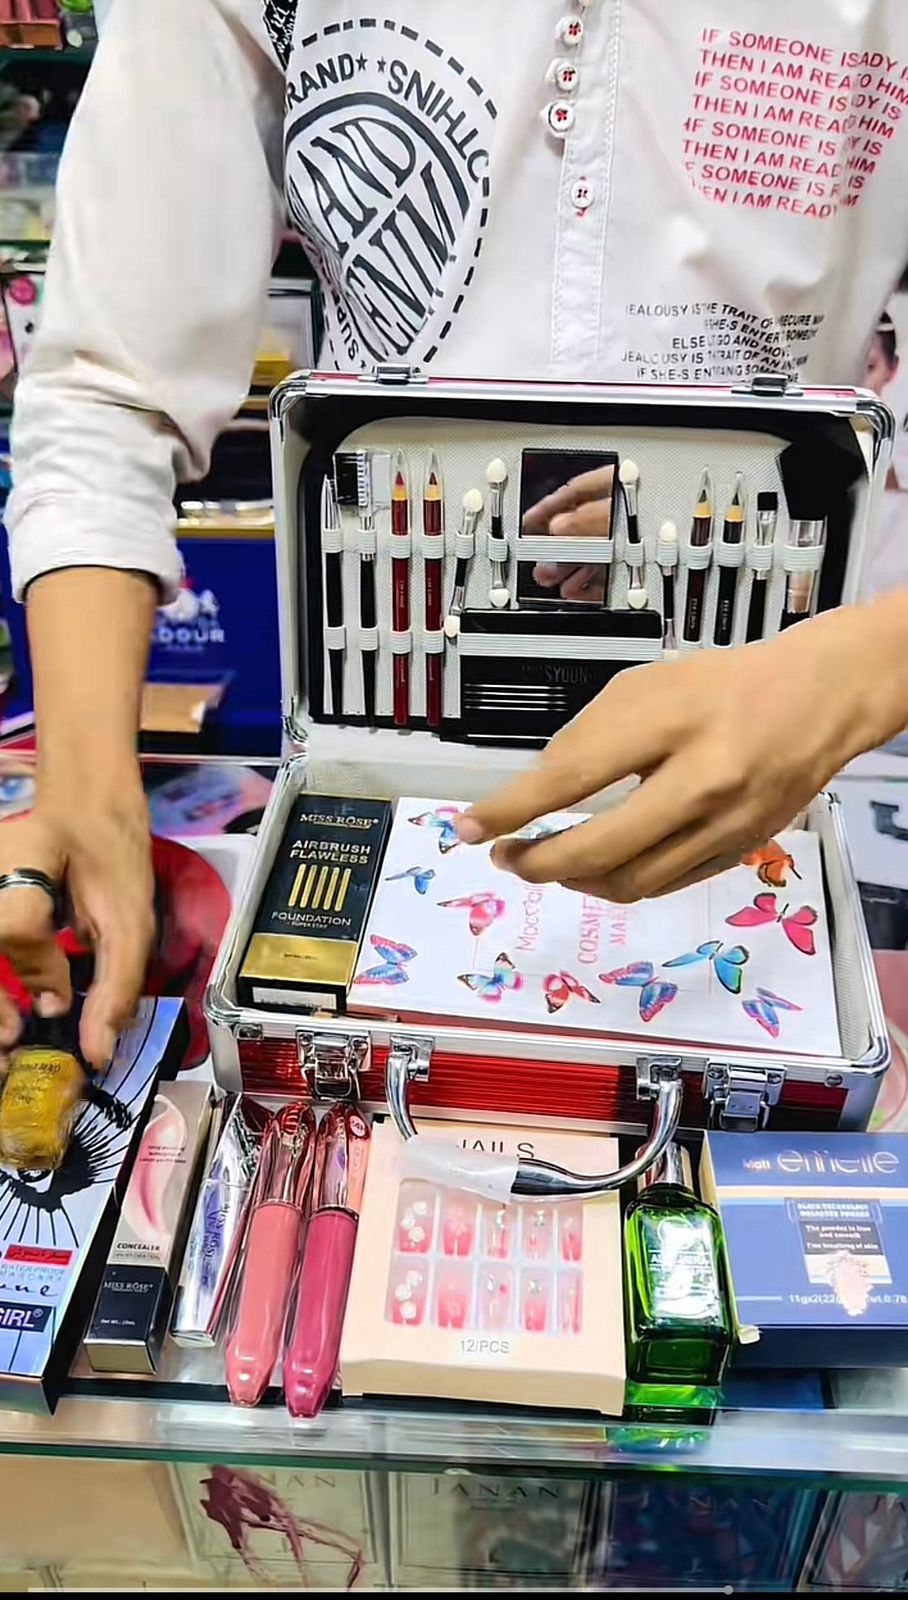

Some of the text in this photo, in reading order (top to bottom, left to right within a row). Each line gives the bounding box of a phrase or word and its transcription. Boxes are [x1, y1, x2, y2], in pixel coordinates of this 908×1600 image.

[702, 28, 722, 43] IF
[729, 31, 834, 64] SOMEONE
[699, 49, 754, 73] THEN
[761, 58, 766, 74] I
[771, 61, 803, 79] AM
[694, 71, 714, 88] IF
[721, 75, 824, 105] SOMEONE
[829, 95, 847, 111] IS
[881, 101, 901, 120] IS
[693, 93, 747, 116] THEN
[753, 103, 758, 118] I
[763, 105, 794, 123] AM
[858, 115, 894, 138] HIM
[684, 117, 705, 132] IF
[712, 121, 811, 150] SOMEONE
[818, 140, 836, 156] IS
[863, 139, 883, 155] IS
[683, 139, 738, 162] THEN
[744, 149, 749, 163] I
[754, 151, 784, 168] AM
[702, 164, 802, 192] SOMEONE
[807, 181, 824, 197] IS
[848, 175, 865, 189] IS
[733, 191, 738, 204] I
[743, 192, 772, 208] AM
[722, 304, 759, 324] TRAIT
[672, 335, 706, 349] ELSE
[733, 335, 759, 348] AND
[691, 352, 703, 364] IS
[743, 350, 760, 361] OF
[760, 356, 780, 369] AN
[300, 813, 333, 824] MISS
[289, 849, 369, 865] FLAWLESS
[292, 840, 371, 855] AIRBRUSH
[271, 911, 352, 926] FOUNDATION
[117, 1243, 160, 1251] CONCEALER
[461, 1339, 510, 1353] 12/PCS
[432, 1477, 561, 1499] JANAN
